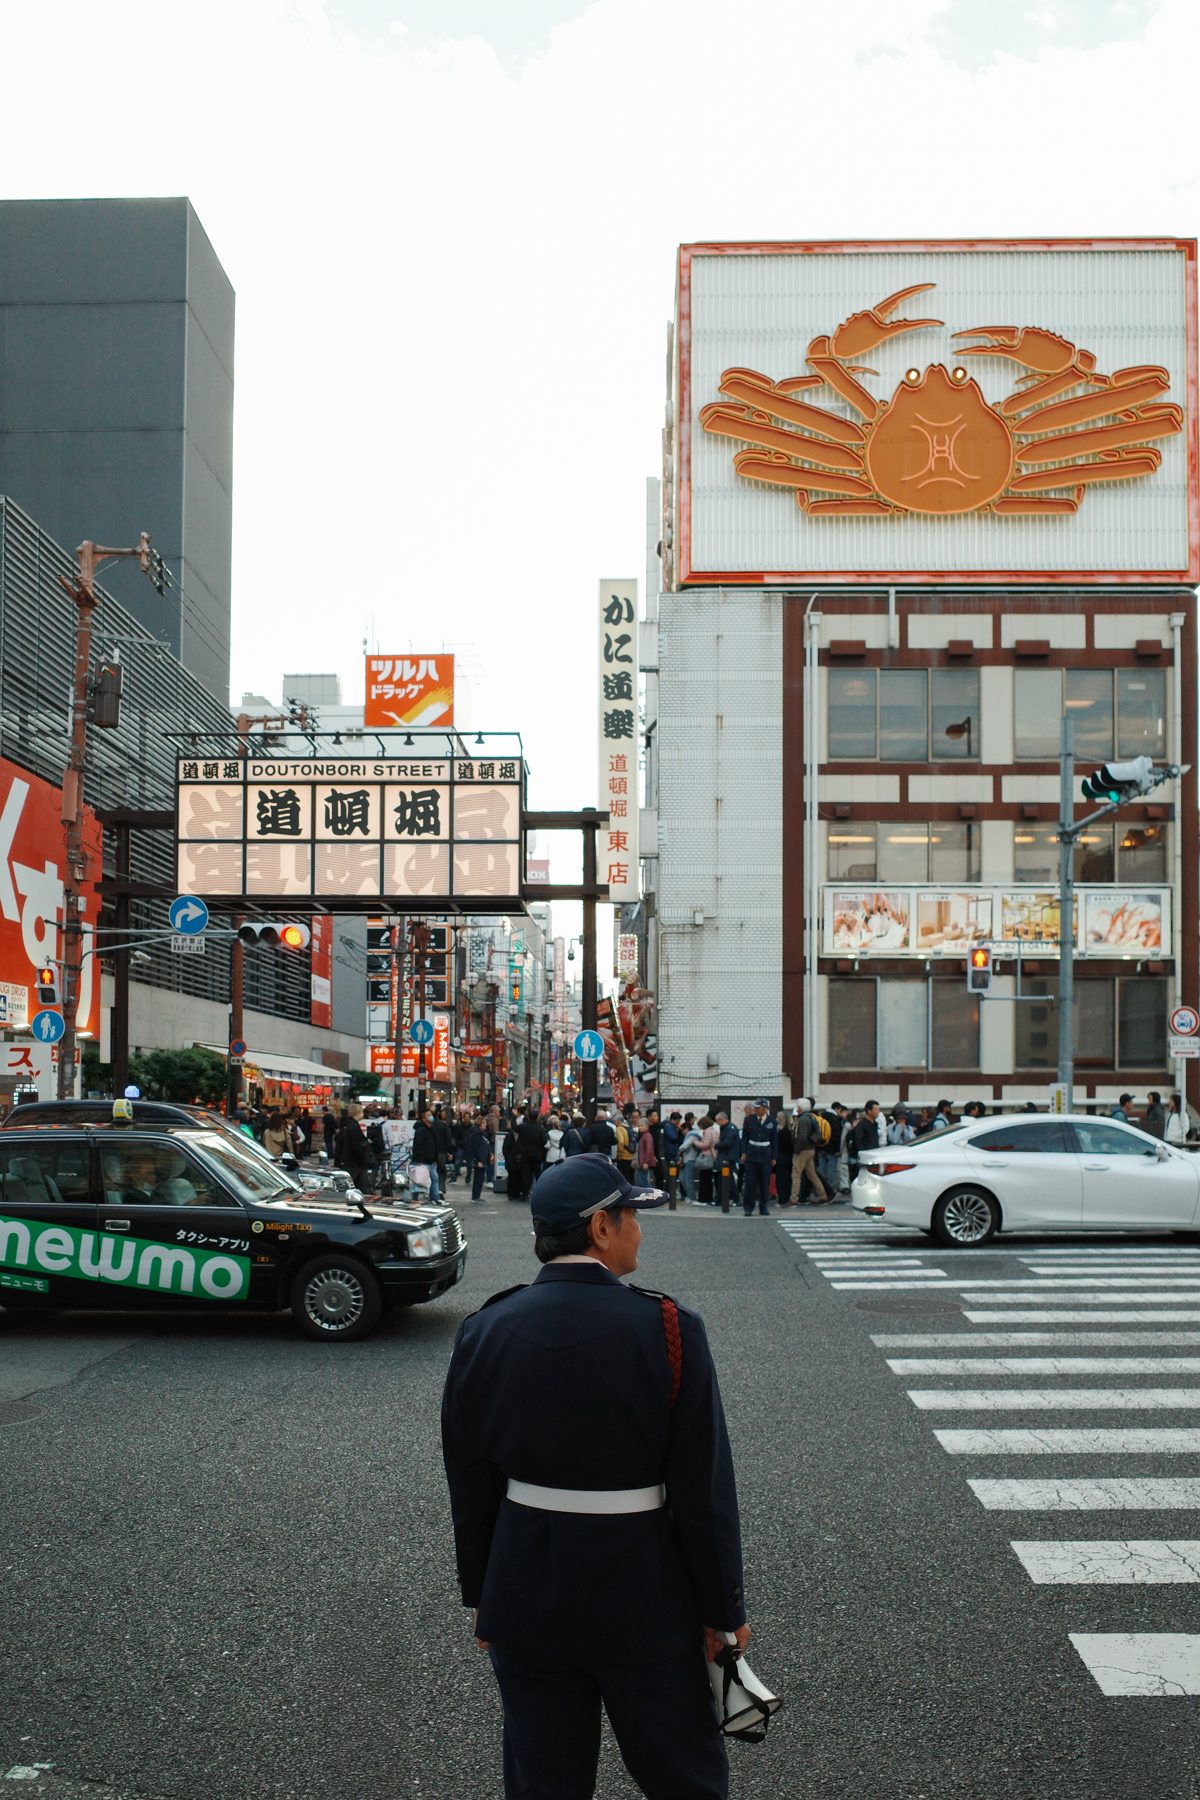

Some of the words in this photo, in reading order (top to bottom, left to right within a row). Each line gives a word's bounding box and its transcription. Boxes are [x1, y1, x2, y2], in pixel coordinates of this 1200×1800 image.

[371, 659, 439, 682] ツルハ
[371, 683, 424, 700] ドラッグ
[183, 762, 239, 779] 道頓堀
[252, 764, 366, 776] DOUTONBORI
[373, 764, 445, 776] STREET
[457, 762, 516, 779] 道頓堀
[255, 788, 441, 837] 道頓堀
[438, 1032, 448, 1065] アカカベ
[266, 1223, 293, 1233] Milight
[297, 1223, 312, 1232] Taxi
[176, 1229, 250, 1252] タクシーアプリ
